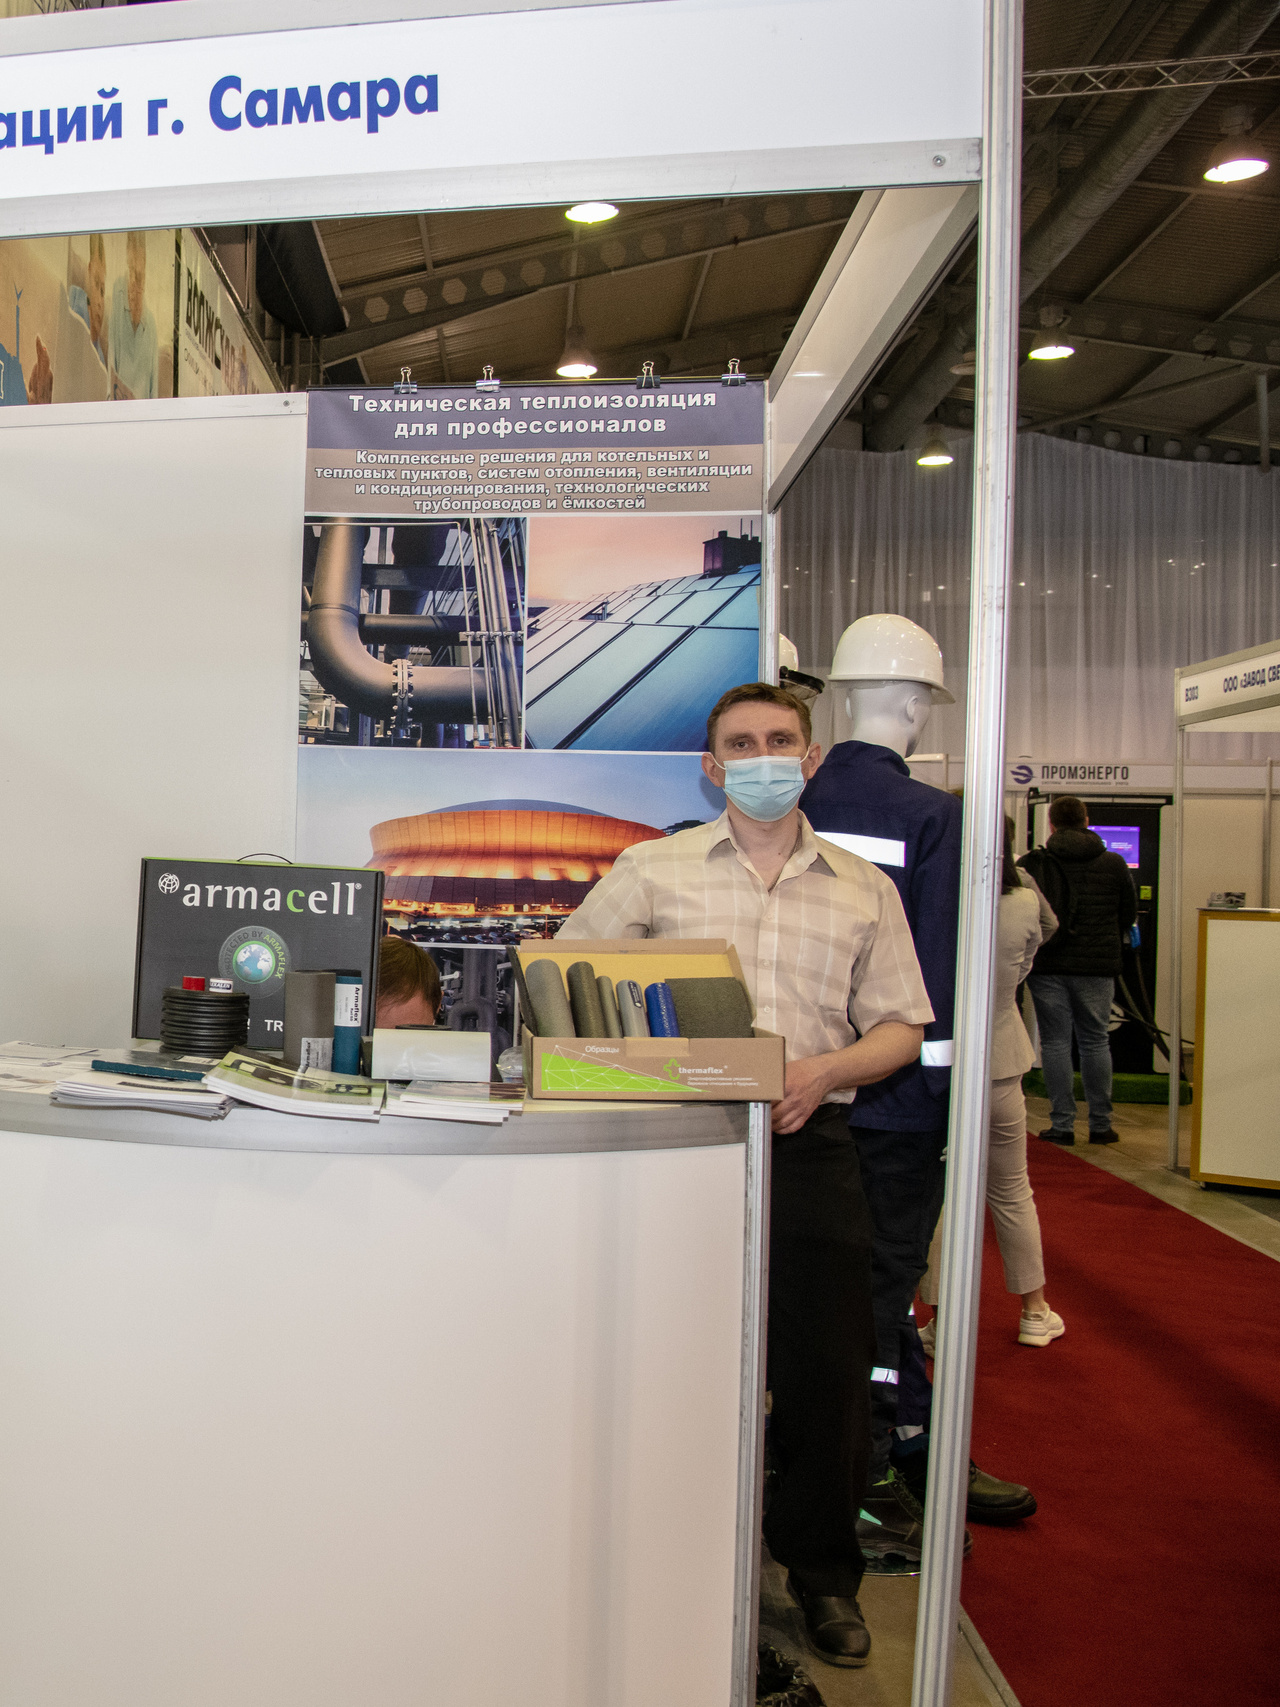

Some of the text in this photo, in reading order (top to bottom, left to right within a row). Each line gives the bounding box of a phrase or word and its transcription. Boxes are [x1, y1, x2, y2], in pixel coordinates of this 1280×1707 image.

[147, 97, 184, 136] г.
[209, 72, 439, 133] Самара
[349, 392, 716, 412] Техническая теплоизоляция
[394, 417, 666, 439] для профессионалов
[356, 450, 710, 466] Комплексные решения для котельных и
[315, 464, 753, 482] тепловых пунктов, систем отопления, вентиляции
[355, 481, 710, 497] и кондиционирования, технологических
[414, 495, 646, 513] трубопроводов и ёмкостей
[1223, 675, 1238, 693] ООО
[1041, 765, 1129, 780] ПРОМЭНЕРГО
[182, 881, 355, 916] armacell
[263, 934, 286, 979] ARMAFLEX
[585, 1045, 619, 1053] Образцы
[678, 1066, 724, 1074] thermaflex
